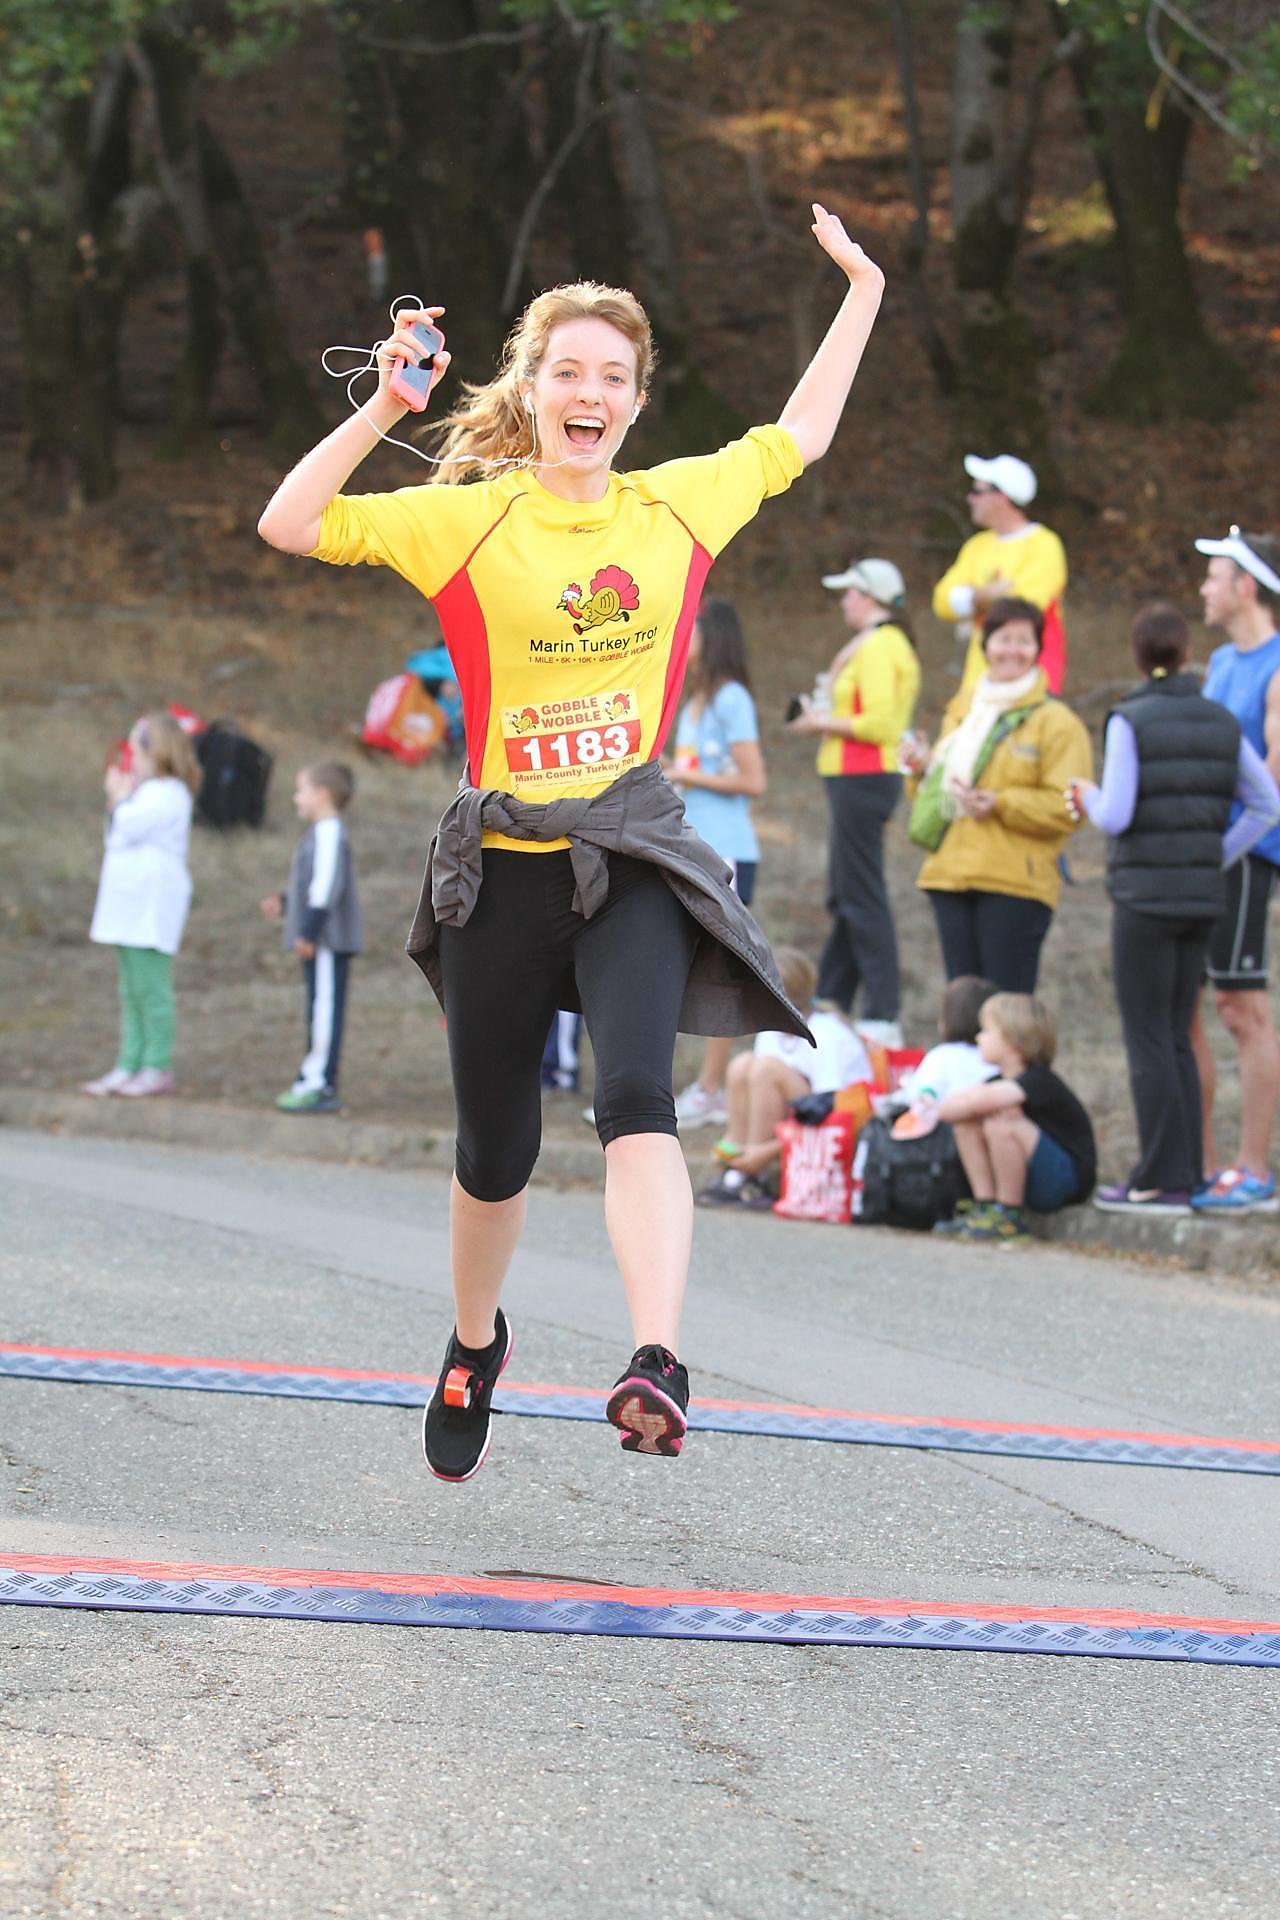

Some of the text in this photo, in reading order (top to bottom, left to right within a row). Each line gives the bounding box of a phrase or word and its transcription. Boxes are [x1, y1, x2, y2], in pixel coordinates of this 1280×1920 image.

[530, 639, 574, 652] Marin
[579, 637, 630, 653] Turkey
[534, 656, 554, 664] MILE
[578, 656, 592, 664] 10K
[598, 650, 629, 662] GOBBLE
[541, 697, 598, 715] GOBBLE
[541, 711, 601, 729] WOBBLE
[522, 726, 630, 770] 1183
[515, 774, 543, 783] Marin
[546, 768, 582, 780] County
[585, 761, 620, 775] Turkey
